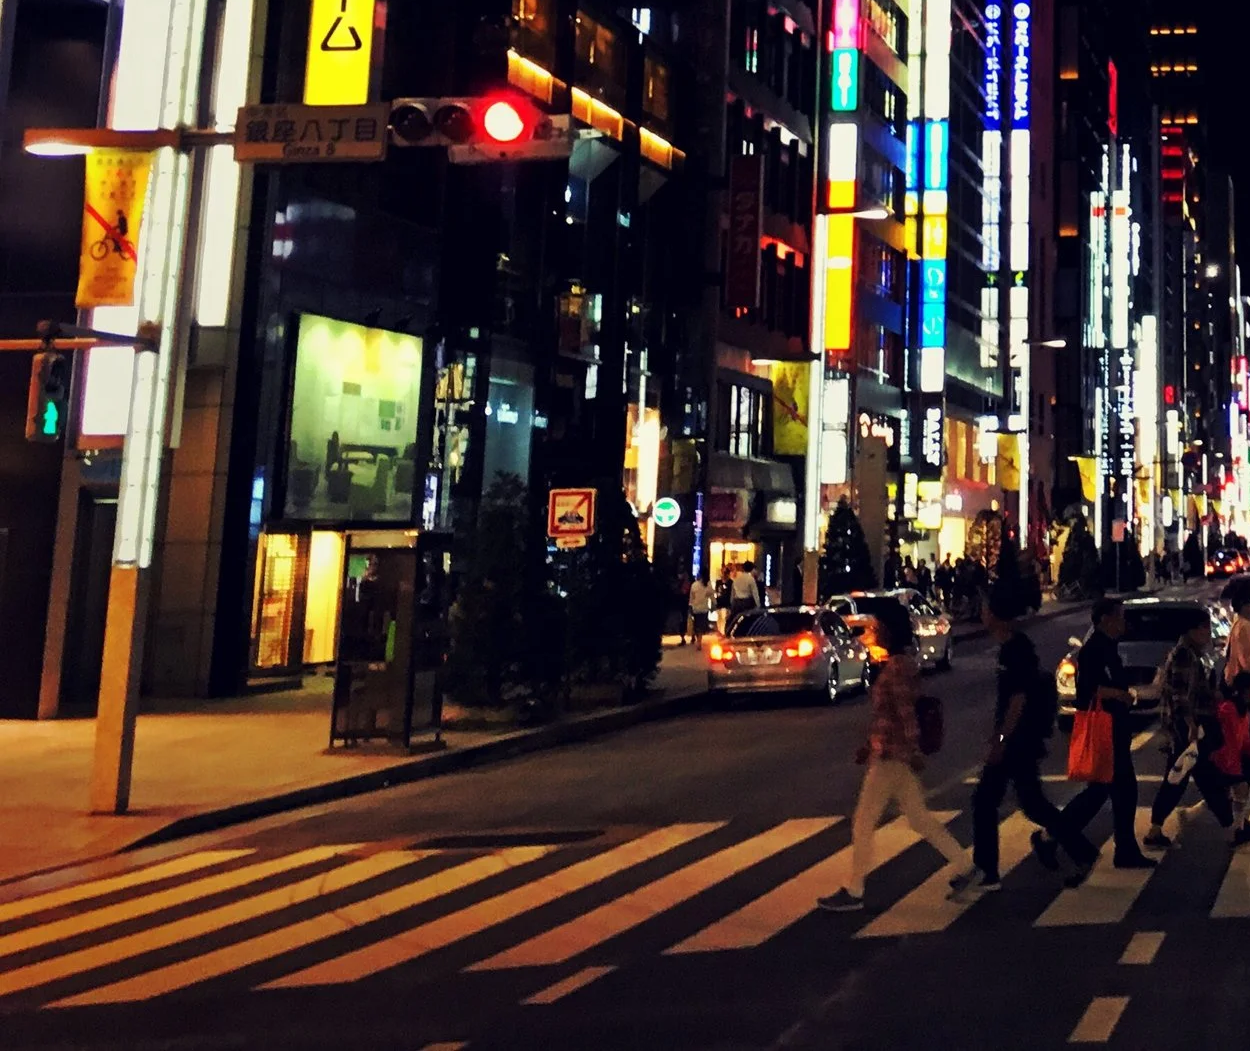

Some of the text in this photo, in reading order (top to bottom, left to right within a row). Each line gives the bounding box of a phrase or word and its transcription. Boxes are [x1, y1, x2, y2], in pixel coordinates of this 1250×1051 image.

[246, 117, 377, 143] 銀座八丁目
